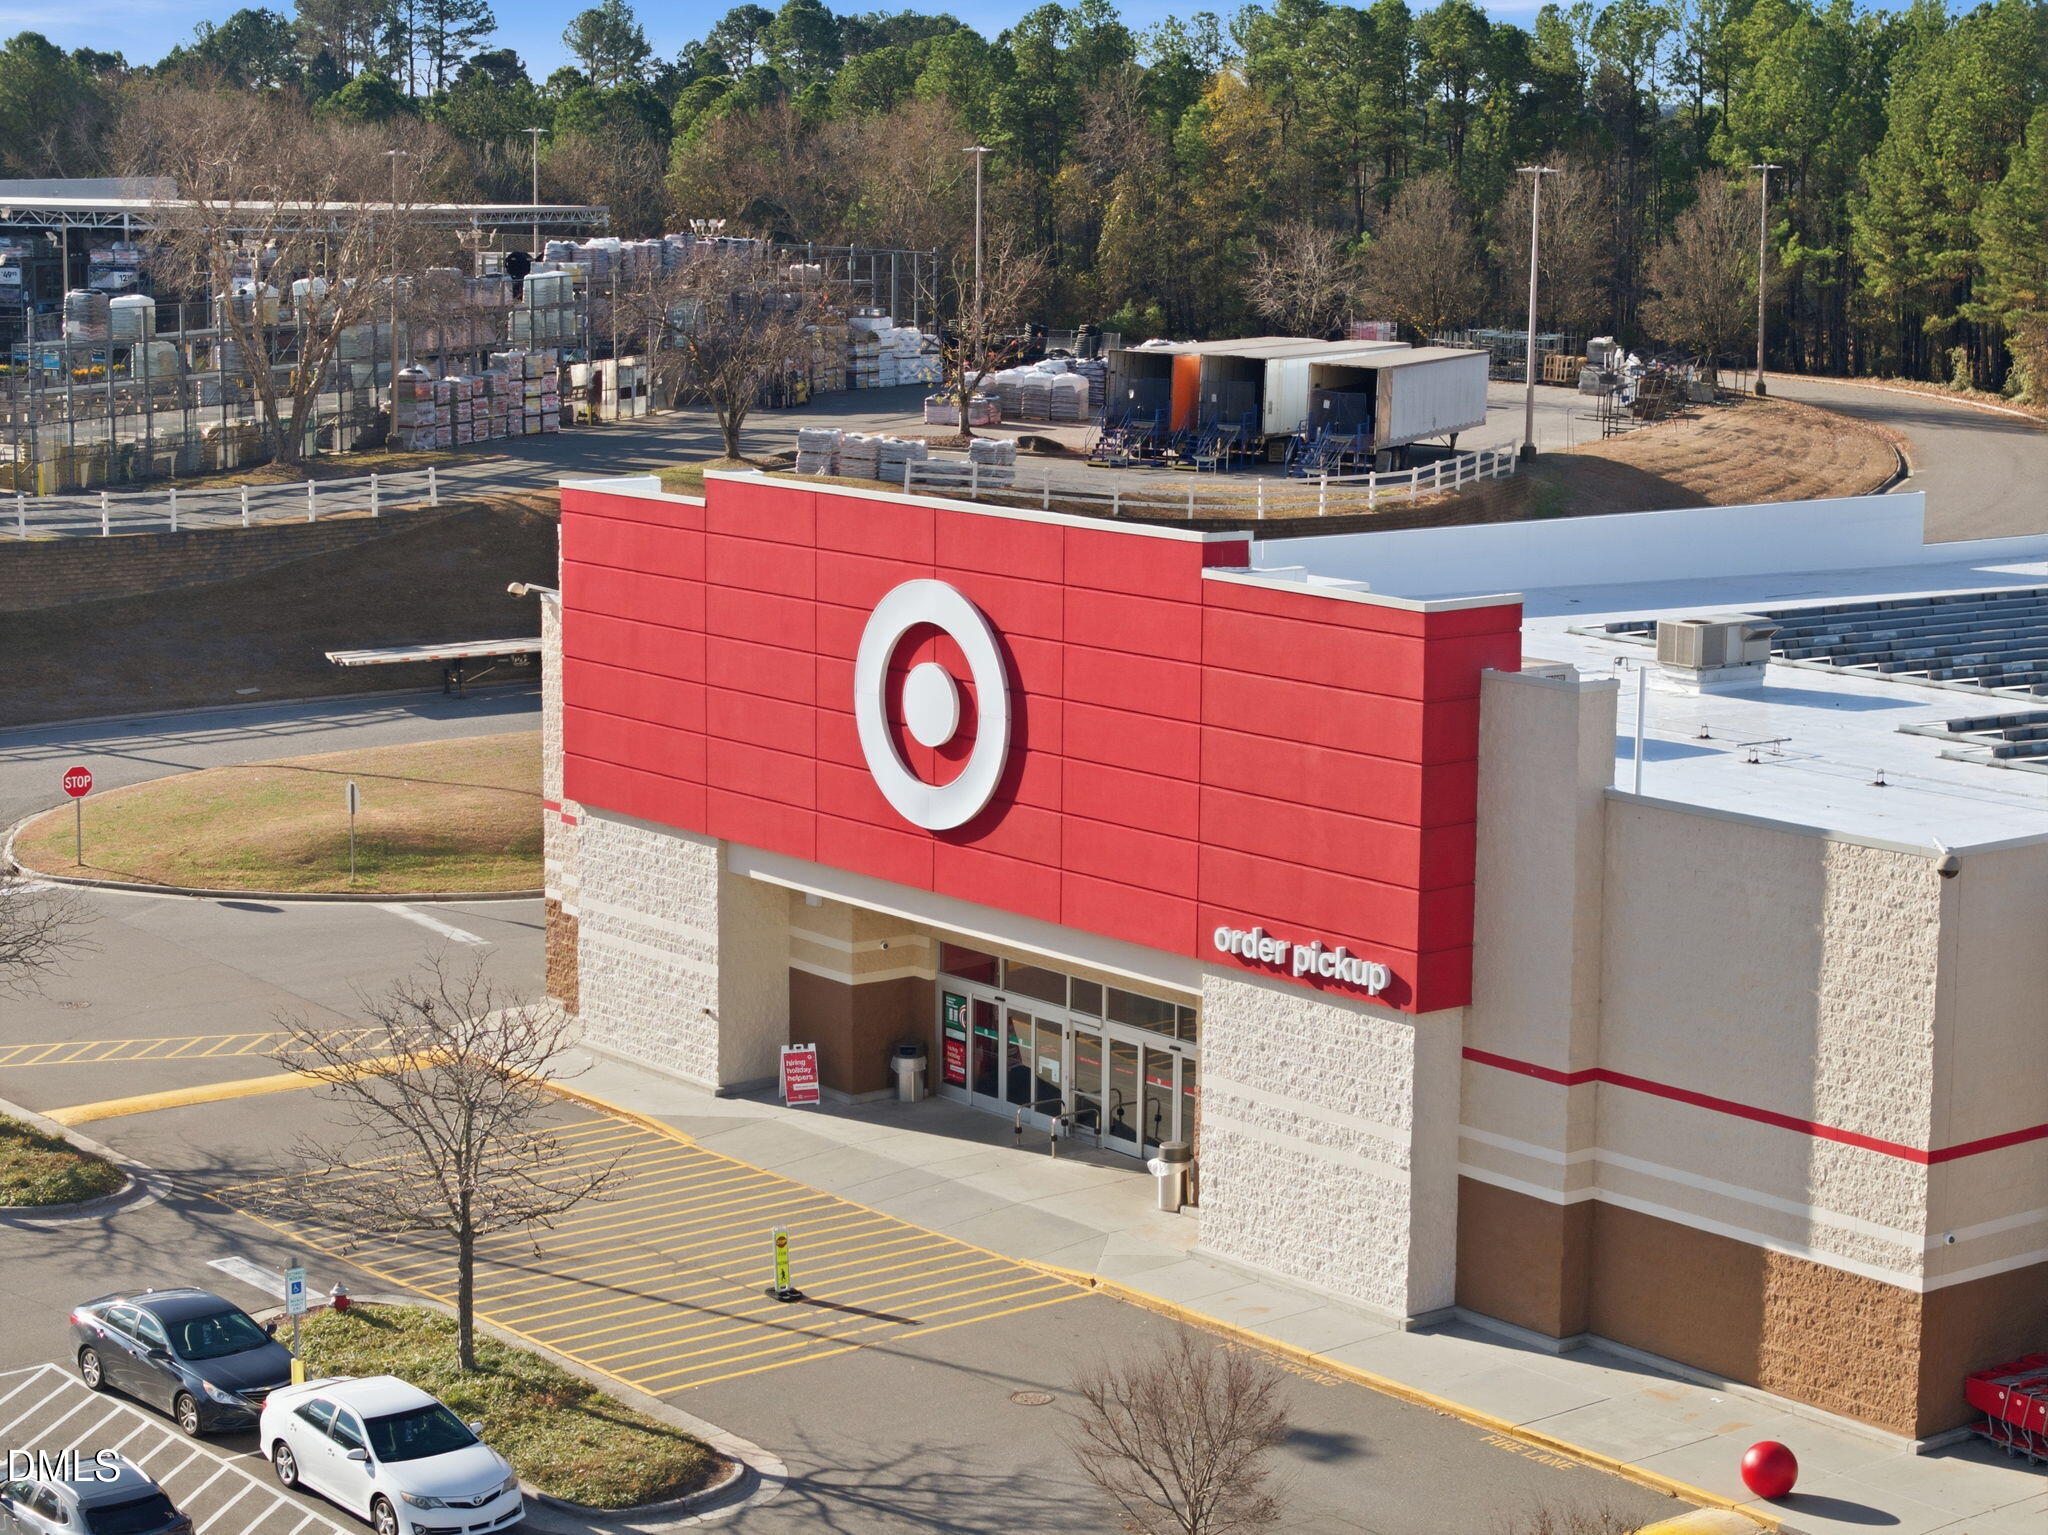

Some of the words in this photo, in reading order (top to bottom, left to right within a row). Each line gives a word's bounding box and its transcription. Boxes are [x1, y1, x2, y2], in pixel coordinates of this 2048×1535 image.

[65, 775, 91, 789] STOP
[1214, 927, 1291, 964] order
[1293, 940, 1391, 996] pickup
[786, 1066, 811, 1074] holiday
[787, 1074, 814, 1082] helpers
[1480, 1434, 1529, 1453] FIRE
[1520, 1449, 1579, 1471] LANE
